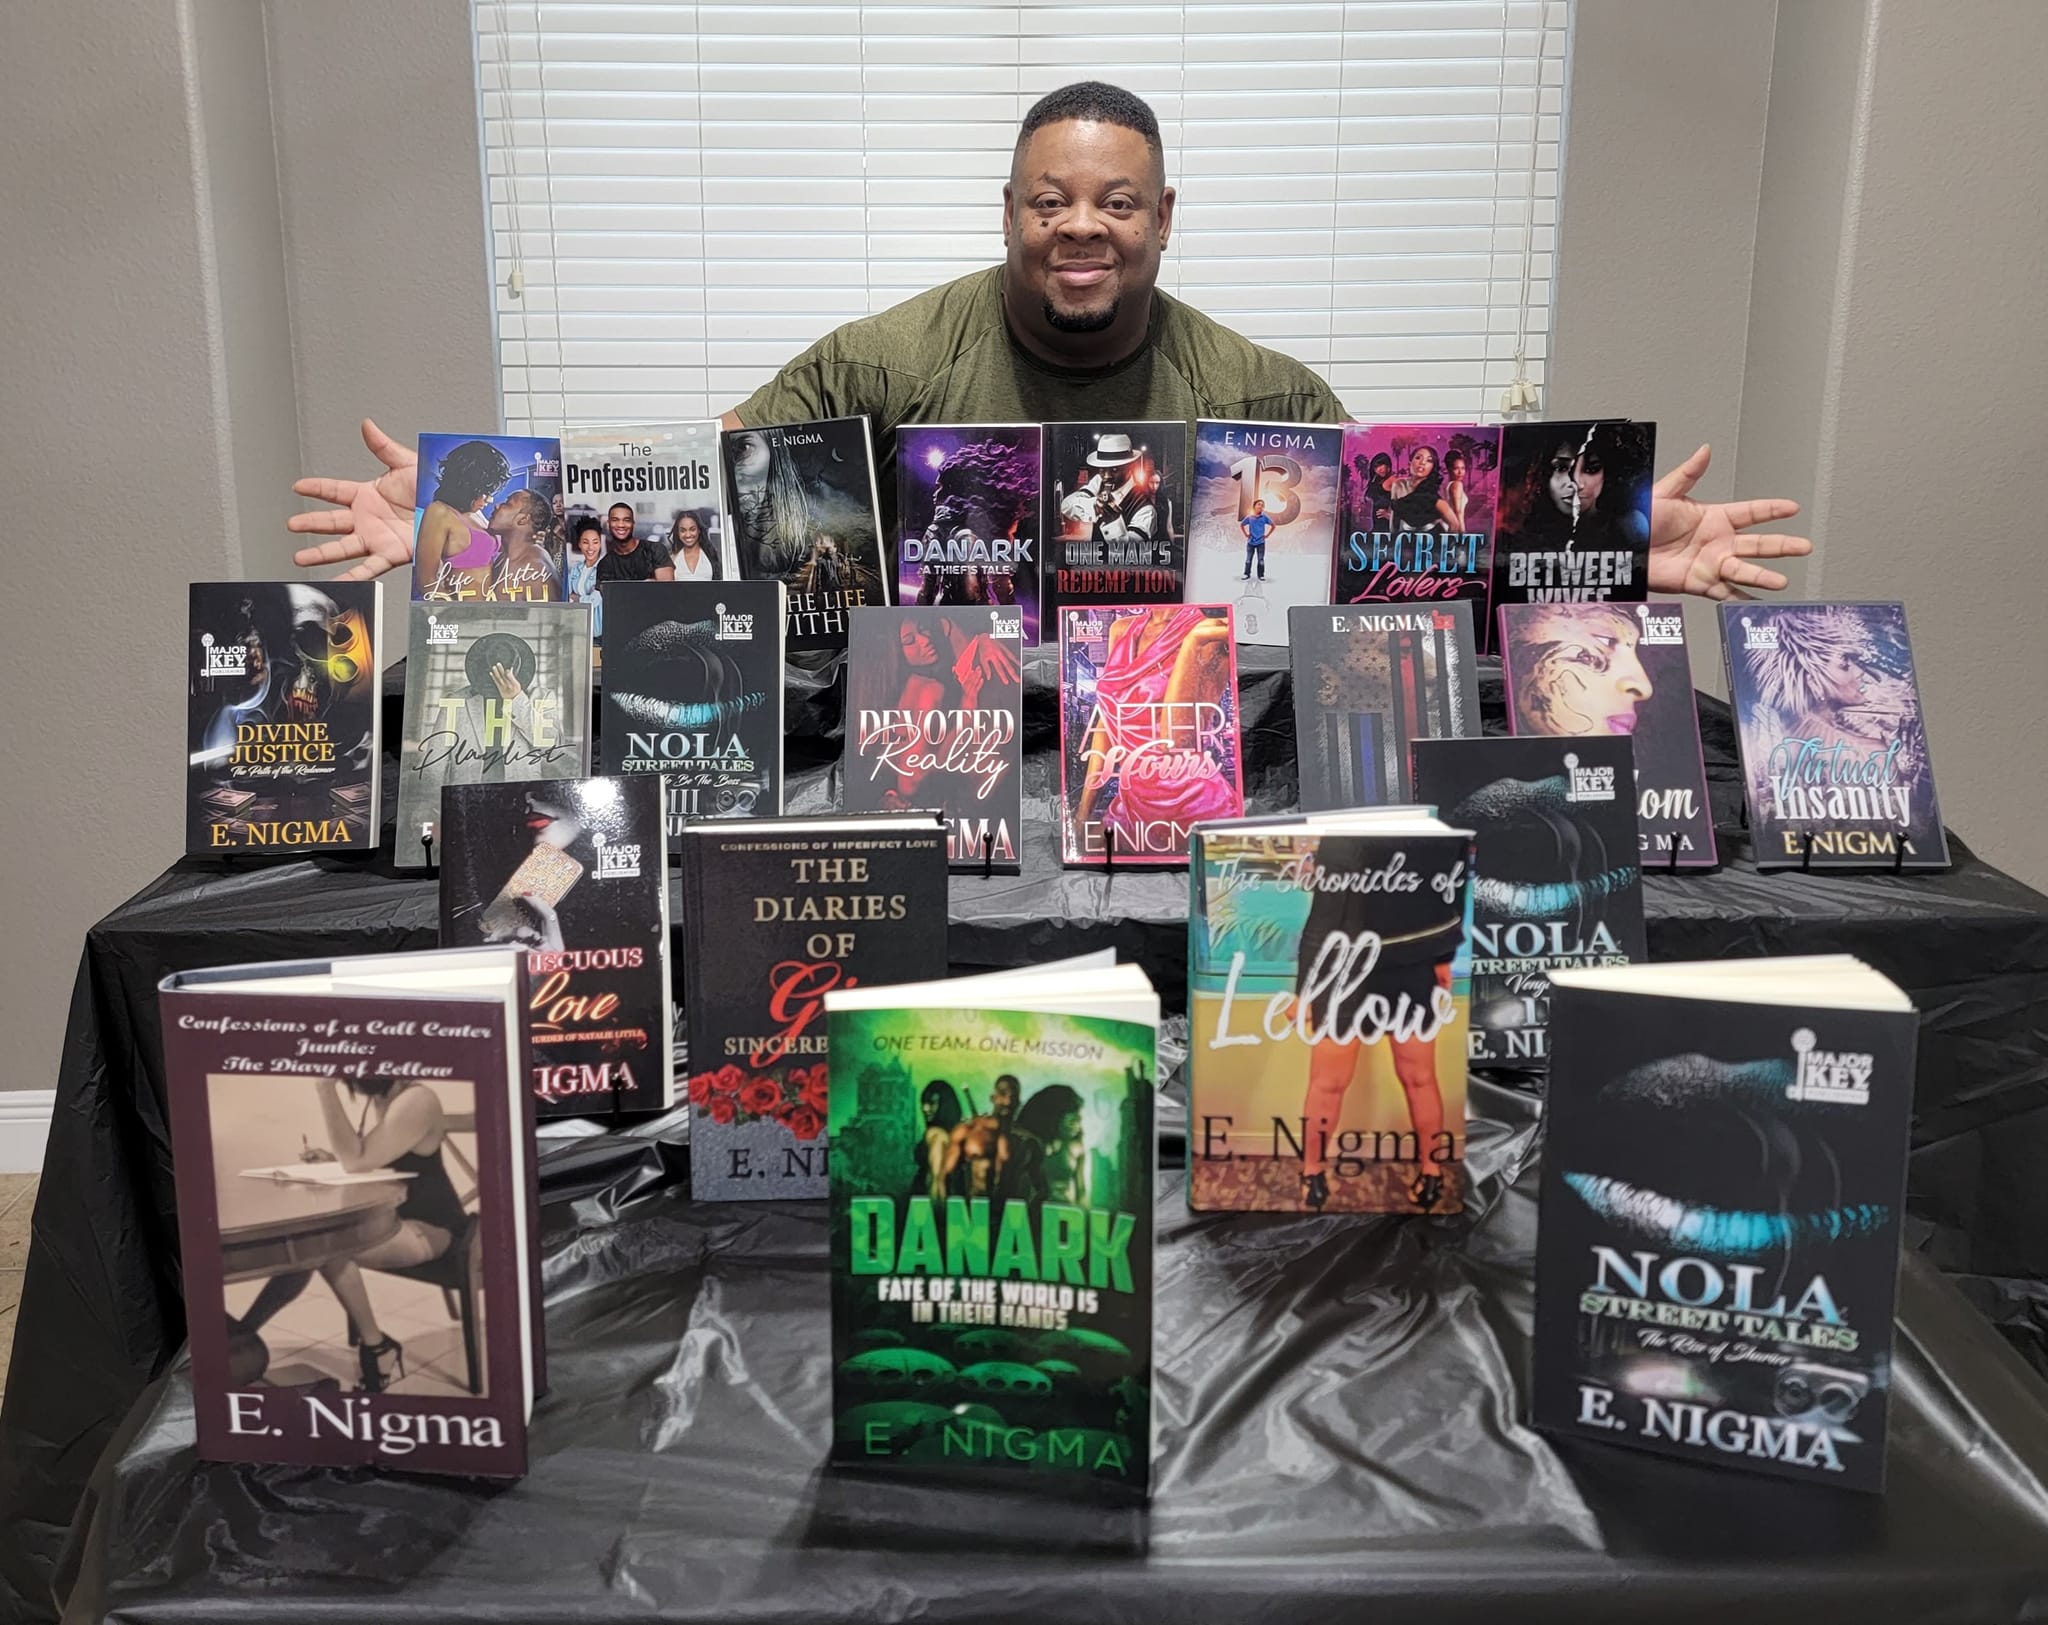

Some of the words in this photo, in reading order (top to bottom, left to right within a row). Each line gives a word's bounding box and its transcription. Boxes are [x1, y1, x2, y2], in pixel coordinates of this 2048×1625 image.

[619, 443, 652, 457] The
[772, 437, 781, 447] E.
[784, 433, 824, 446] NIGMA
[539, 465, 559, 473] KEY
[566, 460, 710, 494] Professionals
[1230, 454, 1303, 526] 13
[904, 539, 1034, 563] DANARK
[1065, 541, 1104, 567] ONE
[1108, 541, 1171, 567] MAN'S
[1348, 531, 1485, 575] SECRET
[424, 561, 475, 600] Life
[481, 558, 552, 598] After
[923, 566, 932, 575] A
[934, 565, 978, 575] THIEF'S
[981, 565, 1010, 575] TALE
[1508, 551, 1634, 587] BETWEEN
[1057, 569, 1178, 595] REDEMPTION
[1350, 561, 1487, 603] Lovers
[787, 593, 818, 613] HE
[823, 589, 867, 609] LIFE
[723, 622, 753, 633] KEY
[995, 625, 1020, 634] KEY
[1077, 626, 1103, 636] KEY
[1331, 616, 1350, 632] E.
[1359, 614, 1426, 632] NIGMA
[1646, 616, 1682, 626] MAJOR
[1648, 625, 1682, 637] KEY
[433, 630, 459, 639] KEY
[1751, 632, 1778, 642] KEY
[209, 646, 247, 654] MAJOR
[210, 654, 247, 668] KEY
[236, 723, 329, 743] DIVINE
[438, 698, 557, 747] THE
[858, 709, 1014, 745] DEVOTED
[1078, 702, 1227, 754] AFTER
[229, 743, 336, 764] JUSTICE
[412, 731, 576, 780] Playlist
[624, 733, 750, 759] NOLA
[231, 766, 246, 777] The
[246, 766, 270, 777] Path
[271, 766, 280, 779] of
[281, 766, 293, 775] the
[622, 760, 694, 772] STREET
[697, 760, 754, 772] TALES
[860, 723, 1009, 799] Reality
[1080, 740, 1222, 790] Hours
[1575, 766, 1615, 777] MAJOR
[1769, 736, 1901, 800] Virtual
[673, 774, 694, 787] Be
[694, 774, 713, 786] The
[1576, 776, 1616, 791] KEY
[1637, 788, 1700, 819] om
[1770, 775, 1912, 827] Insanity
[210, 824, 237, 847] E.
[246, 820, 352, 845] NIGMA
[720, 841, 809, 851] CONFESSIONS
[812, 841, 828, 850] OF
[832, 840, 902, 849] IMPERFECT
[906, 840, 938, 849] LOVE
[943, 818, 1016, 860] GMA
[1113, 820, 1199, 852] NIGM
[1637, 834, 1695, 851] GMA
[601, 844, 641, 855] MAJOR
[602, 854, 641, 869] KEY
[791, 858, 869, 883] THE
[1215, 854, 1261, 892] The
[1431, 861, 1465, 904] of
[753, 894, 907, 922] DIARIES
[806, 933, 856, 958] OF
[1471, 920, 1623, 958] NOLA
[528, 948, 643, 973] ISCUOUS
[1471, 957, 1550, 976] TREET
[1209, 930, 1459, 1050] Lellow
[178, 1015, 307, 1035] Confessions
[313, 1018, 340, 1036] of
[344, 1022, 360, 1035] a
[366, 1020, 418, 1037] Call
[421, 1021, 493, 1039] Center
[565, 1033, 576, 1042] OF
[578, 1031, 614, 1041] NATALIE
[295, 1038, 377, 1056] Junkie:
[873, 1036, 916, 1051] ONE
[978, 1038, 1020, 1054] ONE
[1023, 1040, 1104, 1060] MISSION
[1468, 1030, 1497, 1059] E.
[222, 1056, 265, 1072] The
[270, 1057, 337, 1076] Diary
[342, 1060, 368, 1077] of
[374, 1061, 454, 1078] Lellow
[1808, 1051, 1874, 1069] MAJOR
[532, 1062, 638, 1087] IGMA
[1807, 1066, 1873, 1091] KEY
[1201, 1115, 1247, 1162] E.
[1271, 1116, 1459, 1177] Nigma
[727, 1149, 766, 1179] E.
[850, 1195, 1137, 1294] DANARK
[878, 1276, 924, 1302] FATE
[928, 1277, 955, 1301] OF
[959, 1277, 997, 1302] THE
[1001, 1281, 1074, 1311] WORLD
[1077, 1288, 1099, 1314] IS
[1588, 1245, 1848, 1326] NOLA
[911, 1301, 934, 1323] IN
[938, 1302, 996, 1326] THEIR
[1000, 1304, 1068, 1330] HANDS
[1579, 1291, 1729, 1332] STREET
[1734, 1314, 1860, 1352] TALES
[1637, 1329, 1672, 1350] The
[1669, 1330, 1706, 1354] Rise
[1708, 1340, 1730, 1363] of
[224, 1392, 284, 1437] E.
[302, 1396, 506, 1455] Nigma
[1576, 1385, 1628, 1430] E.
[1640, 1397, 1846, 1473] NIGMA
[865, 1421, 909, 1456] E.
[944, 1423, 1127, 1477] NIGMA
